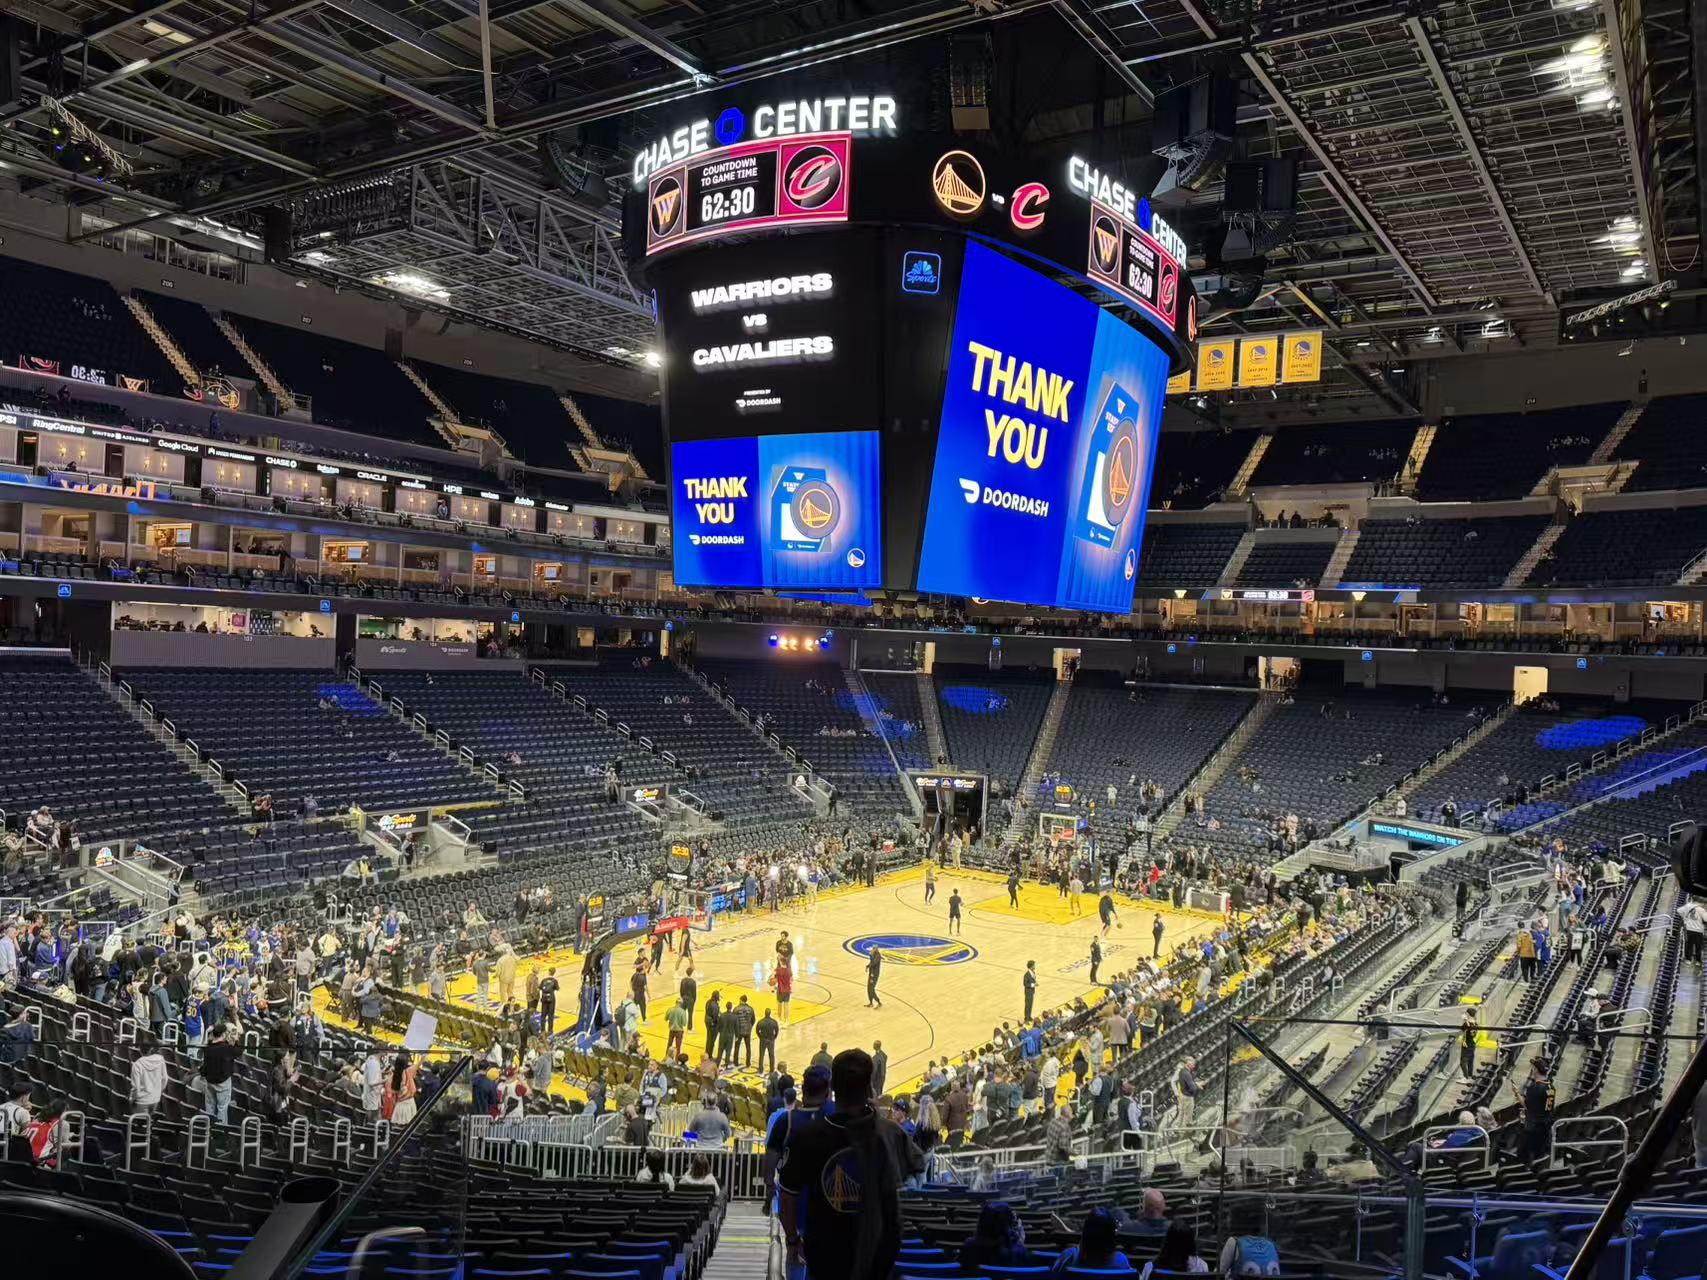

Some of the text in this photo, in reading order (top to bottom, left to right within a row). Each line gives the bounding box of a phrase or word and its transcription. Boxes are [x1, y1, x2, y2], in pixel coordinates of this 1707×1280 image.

[632, 95, 898, 184] CHASE CENTER
[701, 166, 759, 187] TO GAME TIME
[703, 157, 757, 176] COUNTDOWN
[700, 186, 756, 222] 62:30
[1068, 154, 1188, 271] CHASE CENTER
[1130, 237, 1155, 259] COUNTDOWN
[905, 271, 938, 285] Sports
[1128, 263, 1153, 299] 62:30
[690, 272, 834, 308] WARRIORS
[692, 335, 834, 366] CAVALIERS
[968, 340, 1075, 424] THANK
[746, 397, 782, 408] DOORDASH
[32, 418, 86, 435] RingCentral
[158, 439, 199, 453] Google Cloud
[984, 408, 1049, 470] YOU
[265, 456, 291, 468] CHASE
[356, 471, 388, 482] ORACLE
[443, 484, 463, 495] HPE
[683, 475, 748, 501] THANK
[514, 496, 535, 507] Adobe
[984, 486, 1050, 517] DOORDASH
[695, 502, 736, 525] YOU
[701, 534, 745, 546] DOORDASH
[392, 813, 417, 825] Sports
